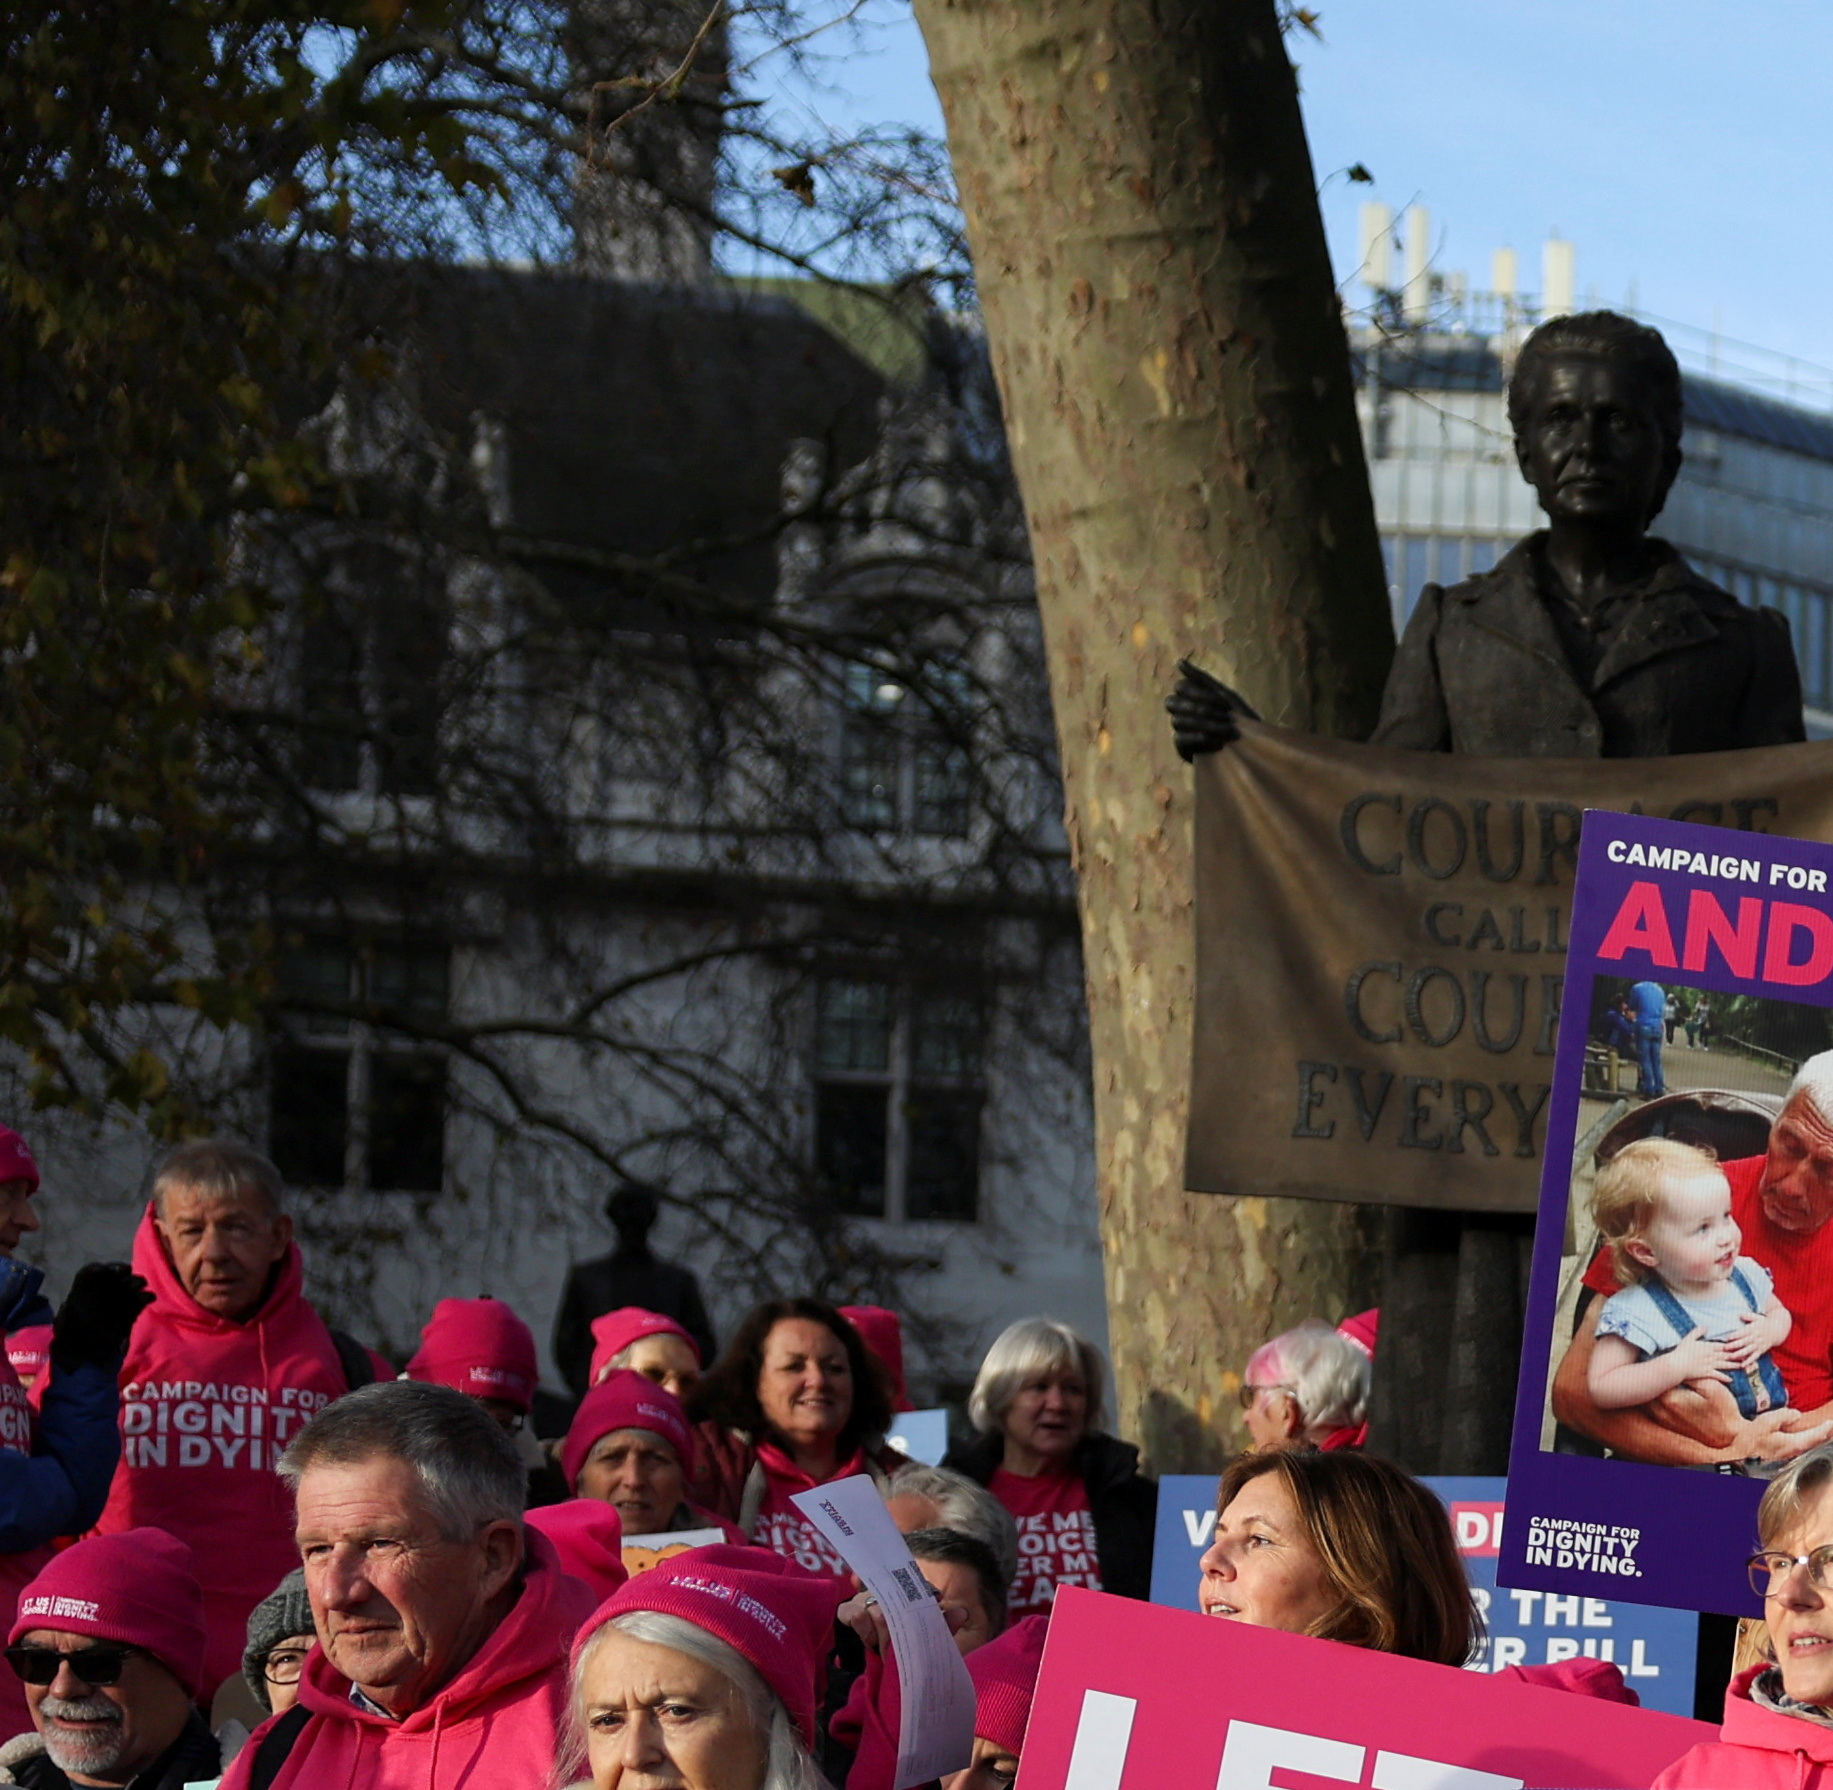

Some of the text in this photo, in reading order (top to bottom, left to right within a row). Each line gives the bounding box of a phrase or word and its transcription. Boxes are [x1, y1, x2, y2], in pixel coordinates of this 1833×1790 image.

[1607, 840, 1827, 893] CAMPAIGN FOR
[123, 1381, 267, 1404] CAMPAIGN
[125, 1436, 166, 1467] IN
[1531, 1516, 1640, 1539] CAMPAIGN FOR
[1018, 1532, 1097, 1555] OICE
[1528, 1528, 1639, 1557] DIGNITY
[1526, 1547, 1642, 1577] IN DYING.
